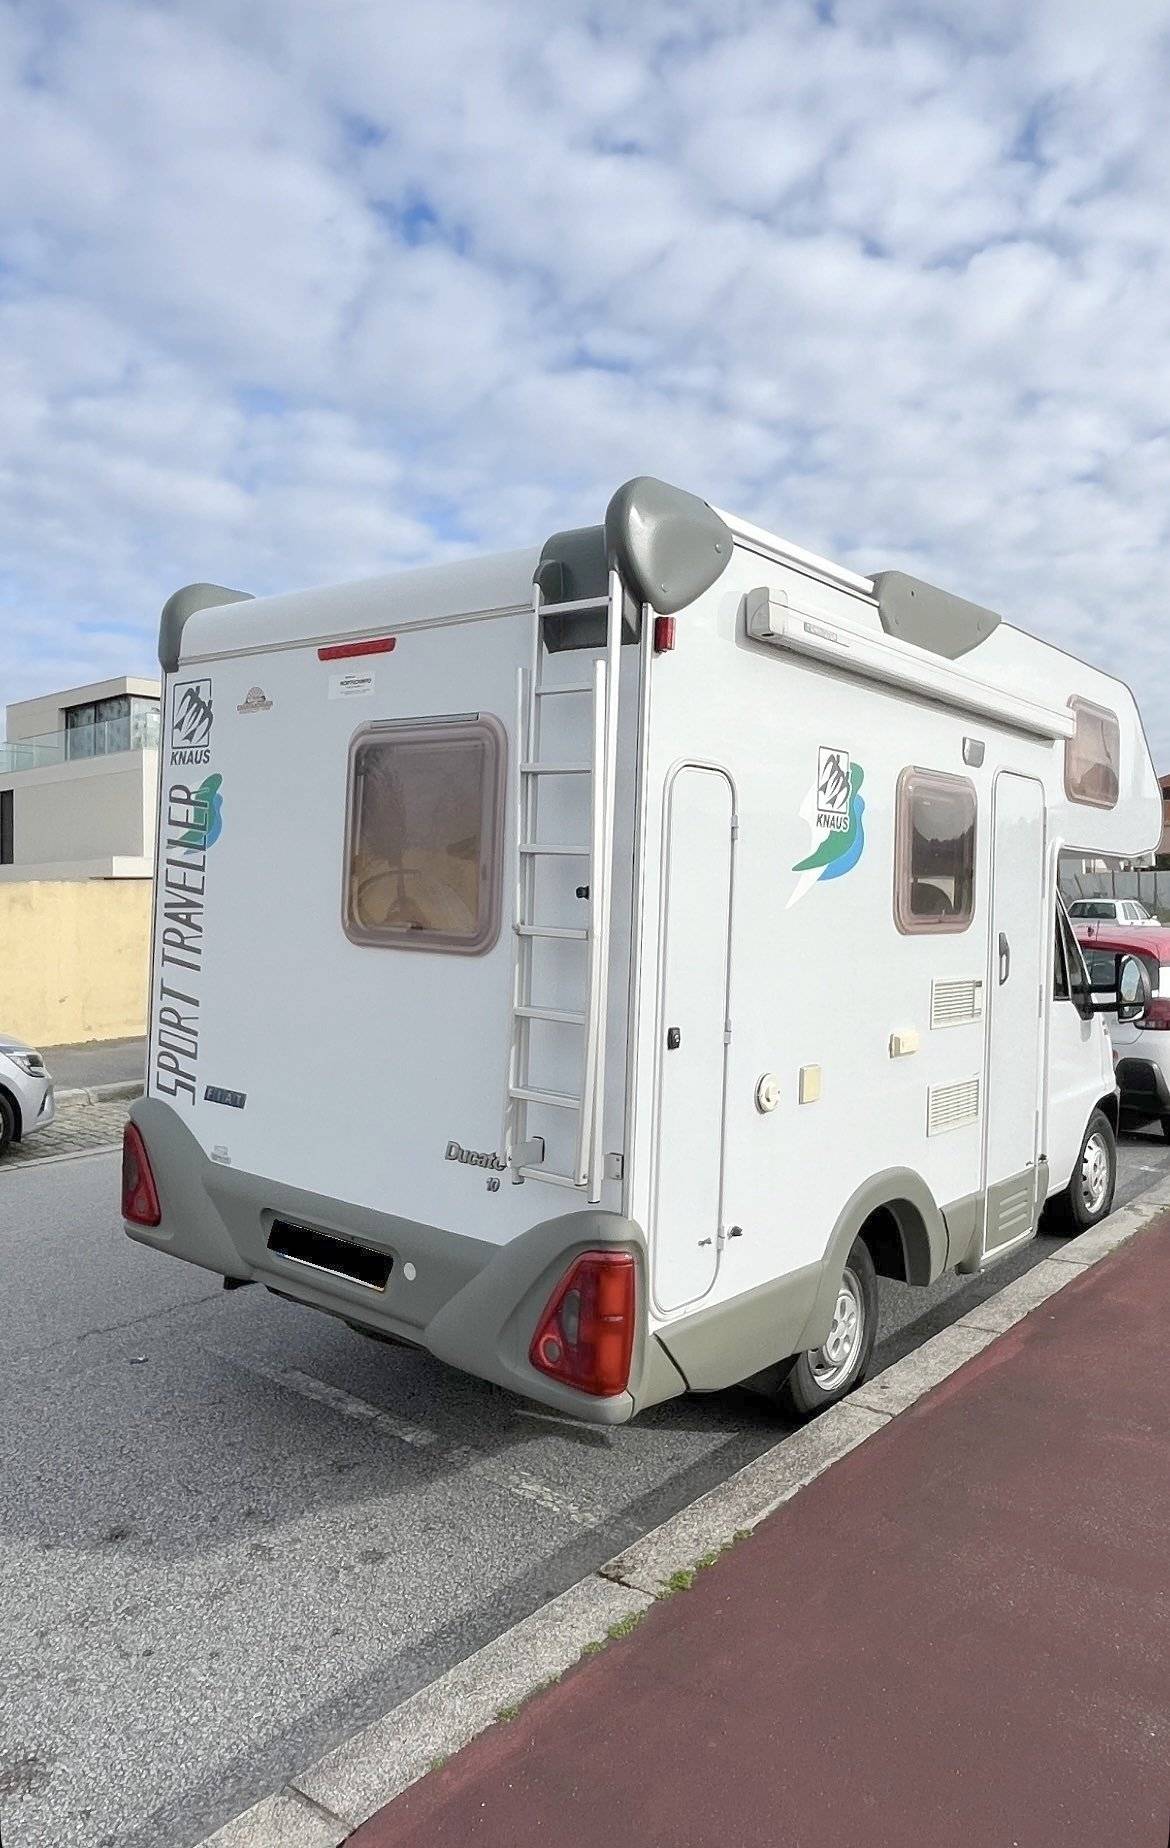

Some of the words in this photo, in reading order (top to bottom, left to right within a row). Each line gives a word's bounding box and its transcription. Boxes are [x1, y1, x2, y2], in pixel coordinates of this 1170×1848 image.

[170, 749, 211, 766] KNAUS
[816, 813, 848, 831] KNAUS
[161, 784, 209, 971] TRAVELLER
[156, 977, 201, 1106] SPORT
[206, 1087, 243, 1106] FIAT
